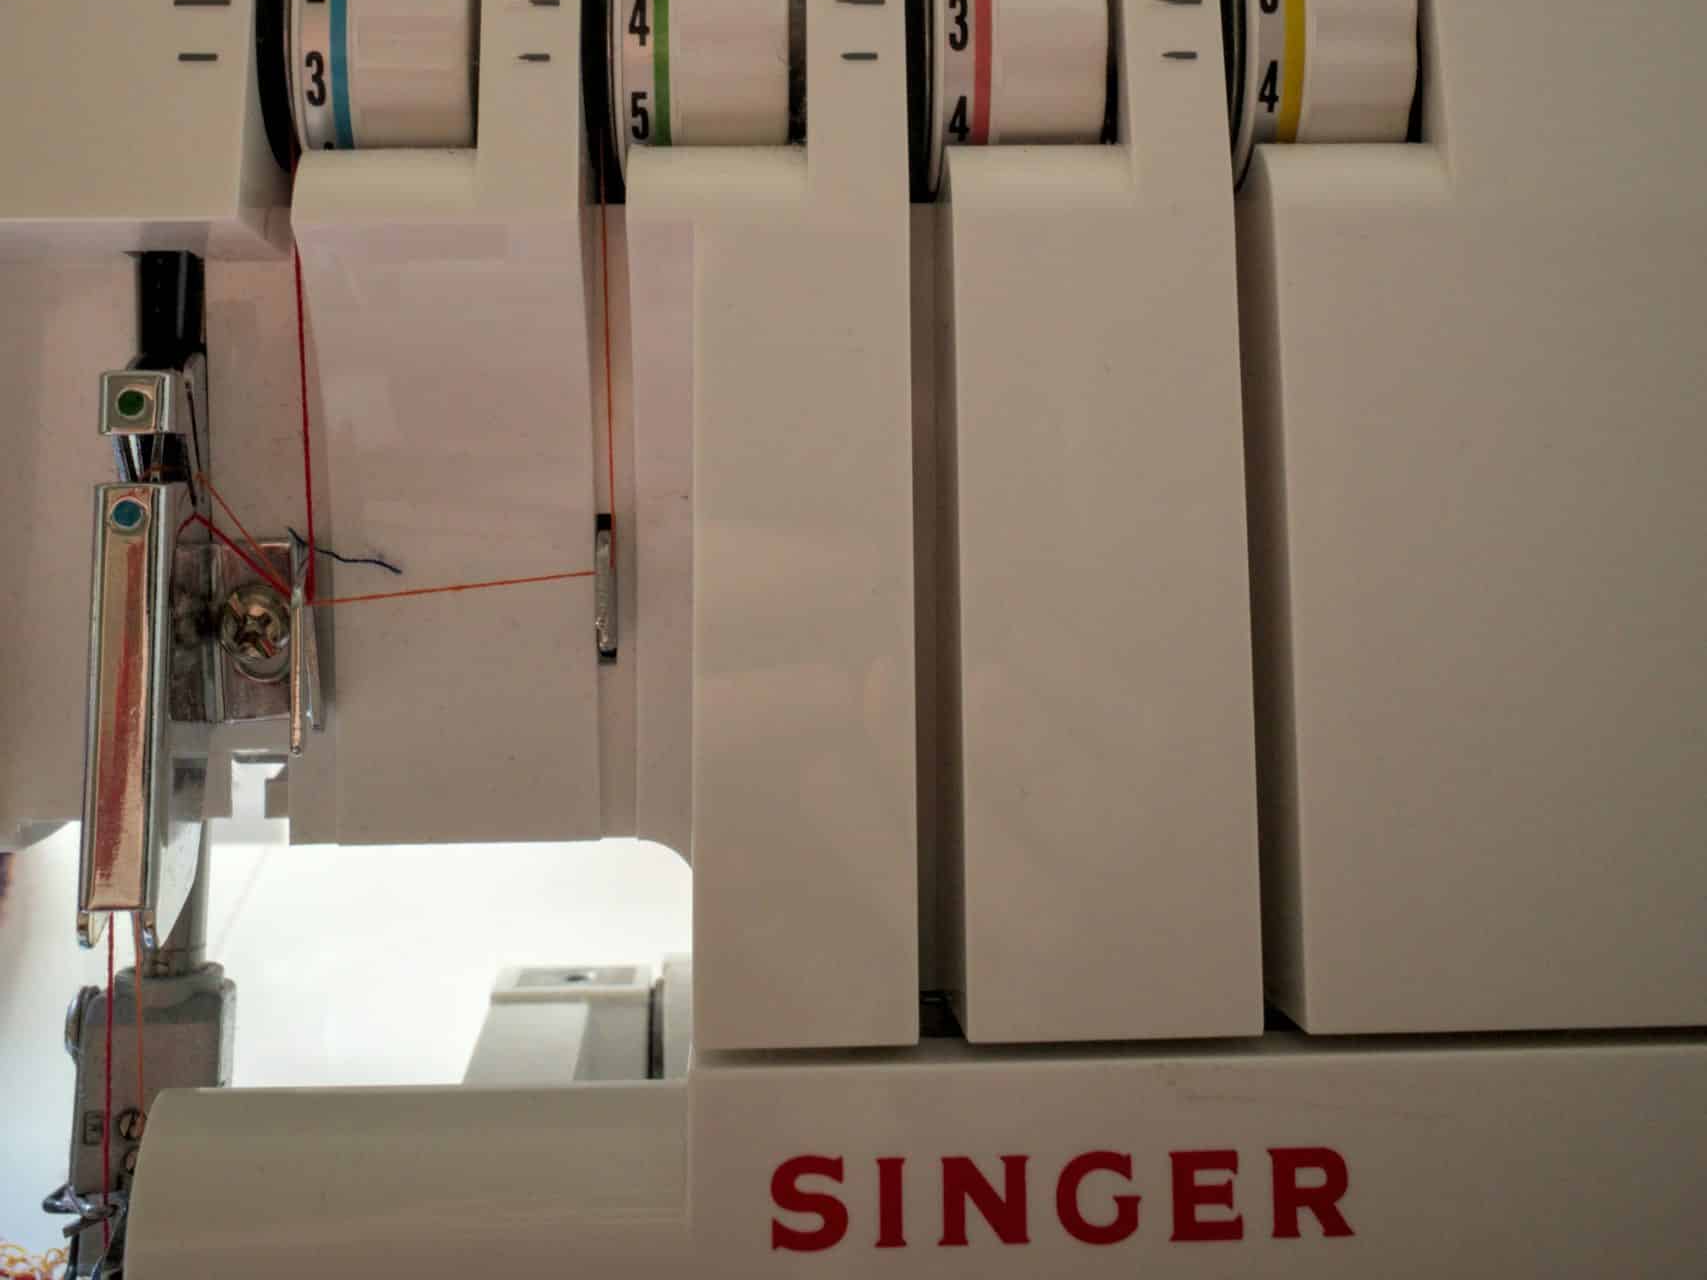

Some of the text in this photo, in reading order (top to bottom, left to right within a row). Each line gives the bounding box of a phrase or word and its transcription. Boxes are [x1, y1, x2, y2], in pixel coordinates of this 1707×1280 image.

[305, 51, 326, 107] 3
[1258, 60, 1279, 112] 4
[631, 92, 649, 140] 5
[949, 96, 970, 142] 4
[770, 1147, 1355, 1252] SINGER
